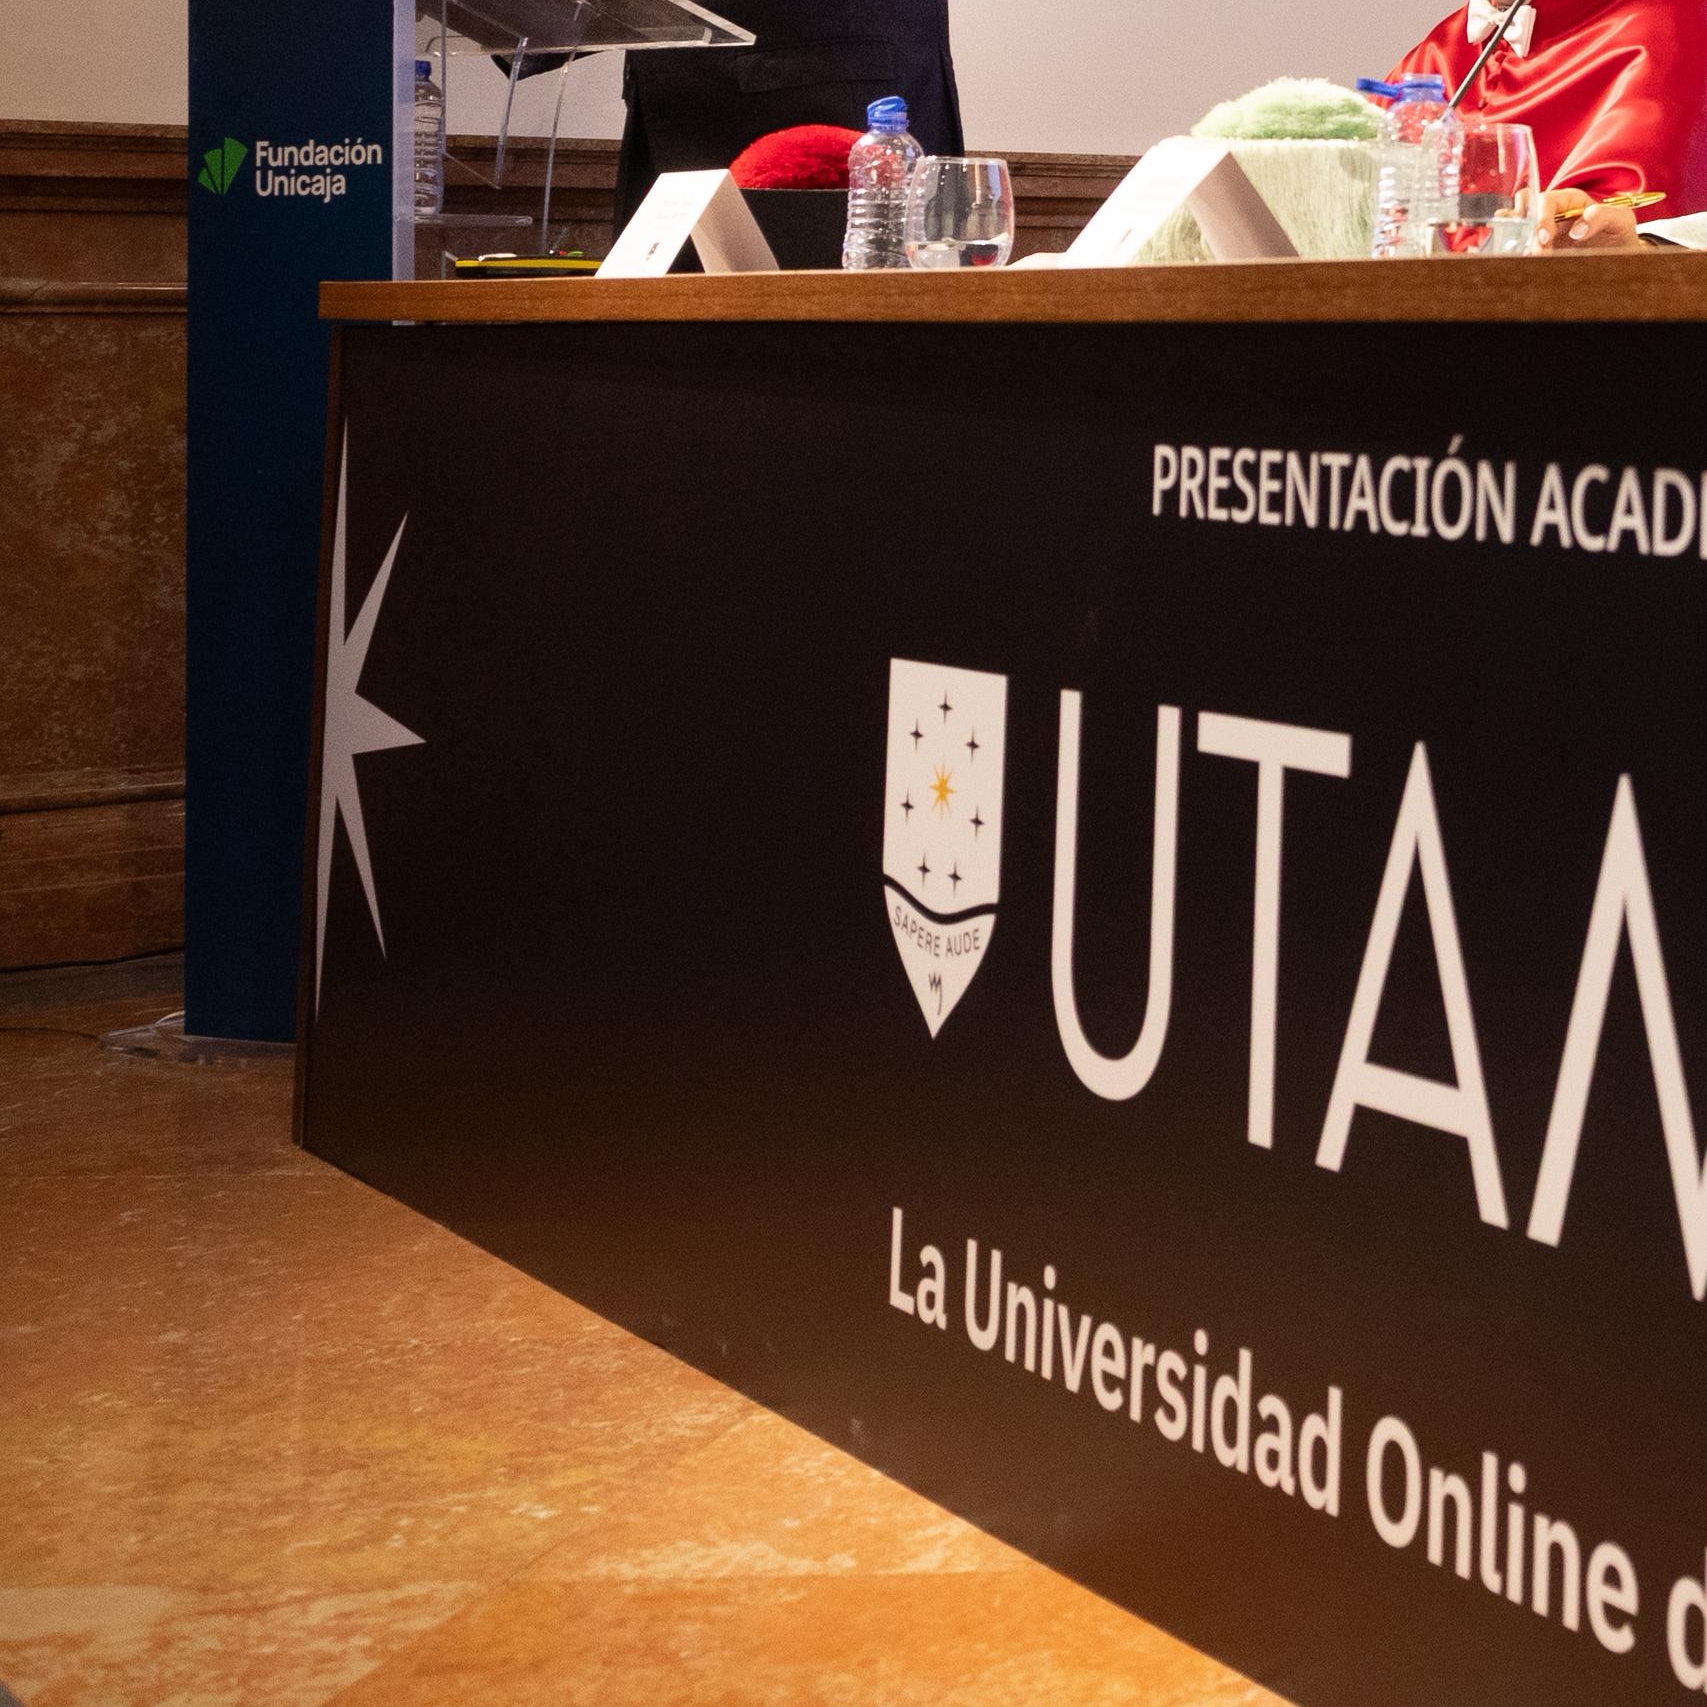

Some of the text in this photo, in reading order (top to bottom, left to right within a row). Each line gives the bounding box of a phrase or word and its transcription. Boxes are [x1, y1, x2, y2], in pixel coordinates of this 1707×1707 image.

[256, 137, 383, 167] Fundación
[256, 168, 346, 203] Unicaja
[1152, 434, 1516, 545] PRESENTACIÓN
[894, 905, 981, 958] SAPERE AUDE
[889, 1207, 948, 1330] La
[965, 1237, 1343, 1518] Universidad
[1366, 1415, 1639, 1654] Online
